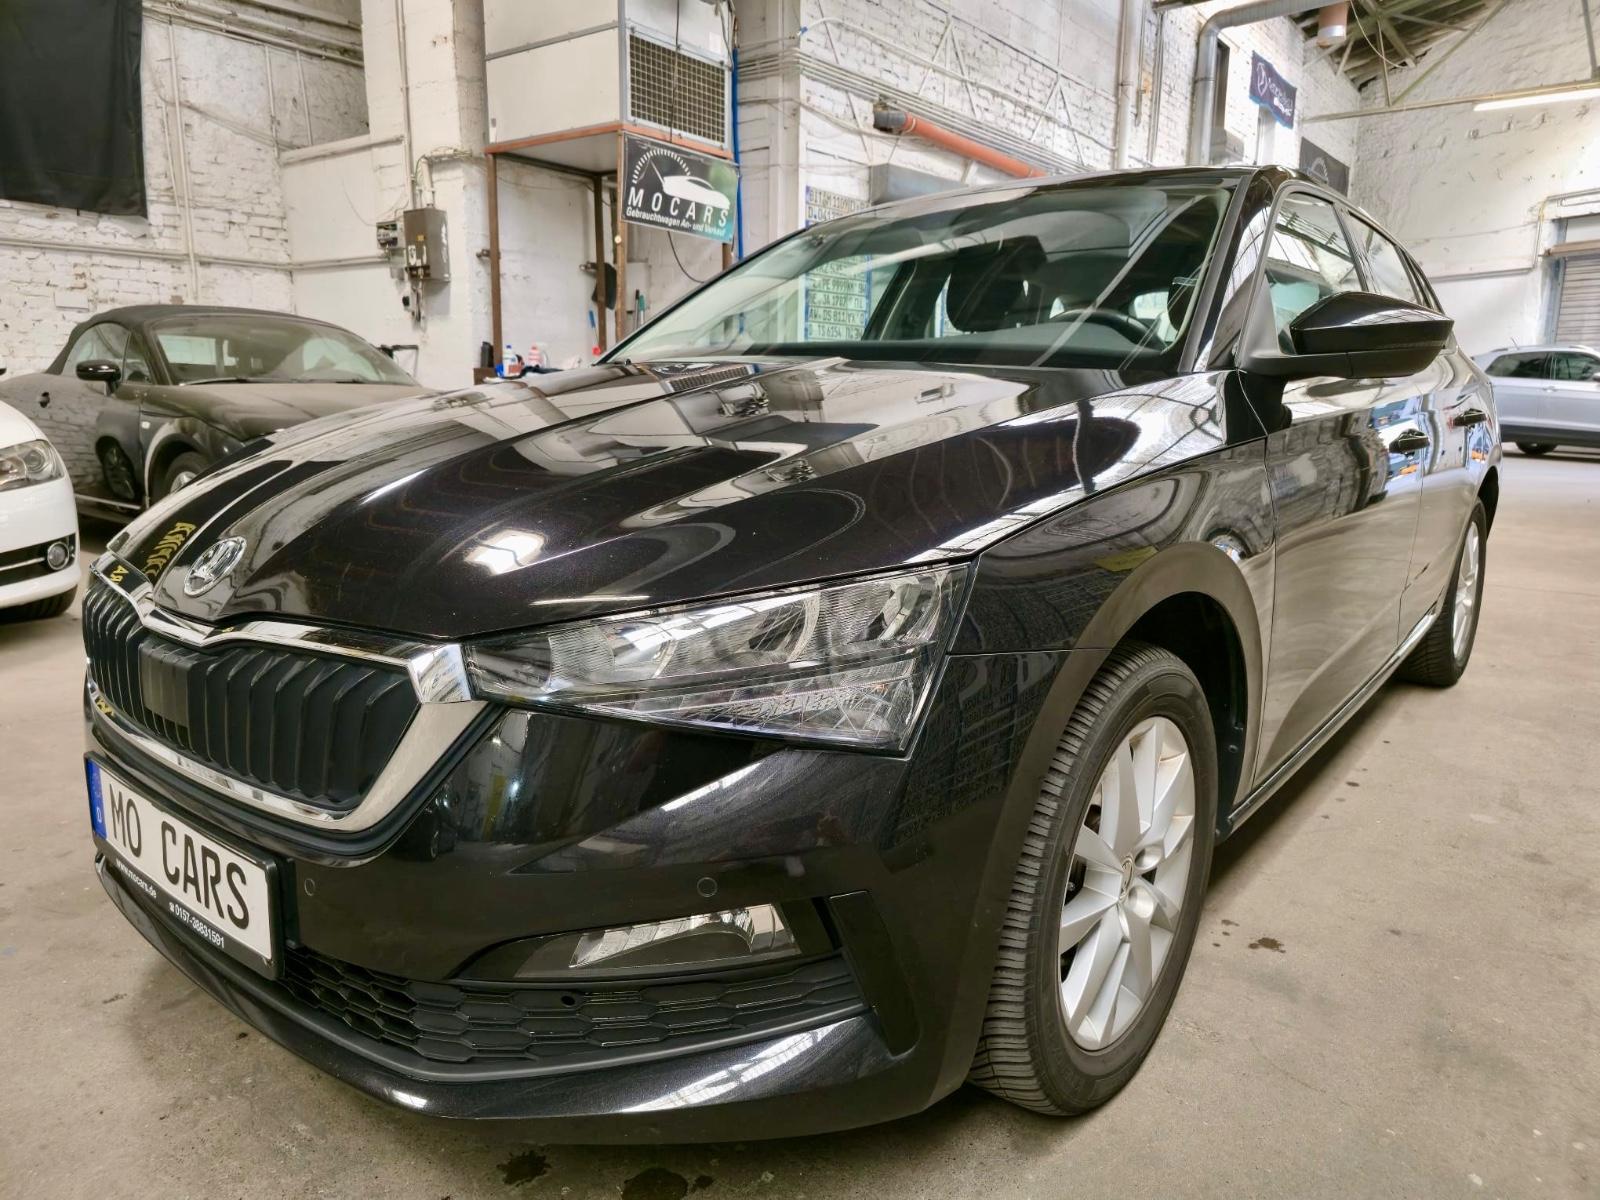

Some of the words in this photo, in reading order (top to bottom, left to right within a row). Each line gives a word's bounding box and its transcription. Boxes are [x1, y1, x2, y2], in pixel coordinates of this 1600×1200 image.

[96, 807, 103, 824] D
[109, 784, 142, 858] MO
[161, 820, 250, 930] CARS
[115, 859, 157, 899] www.mocars.de
